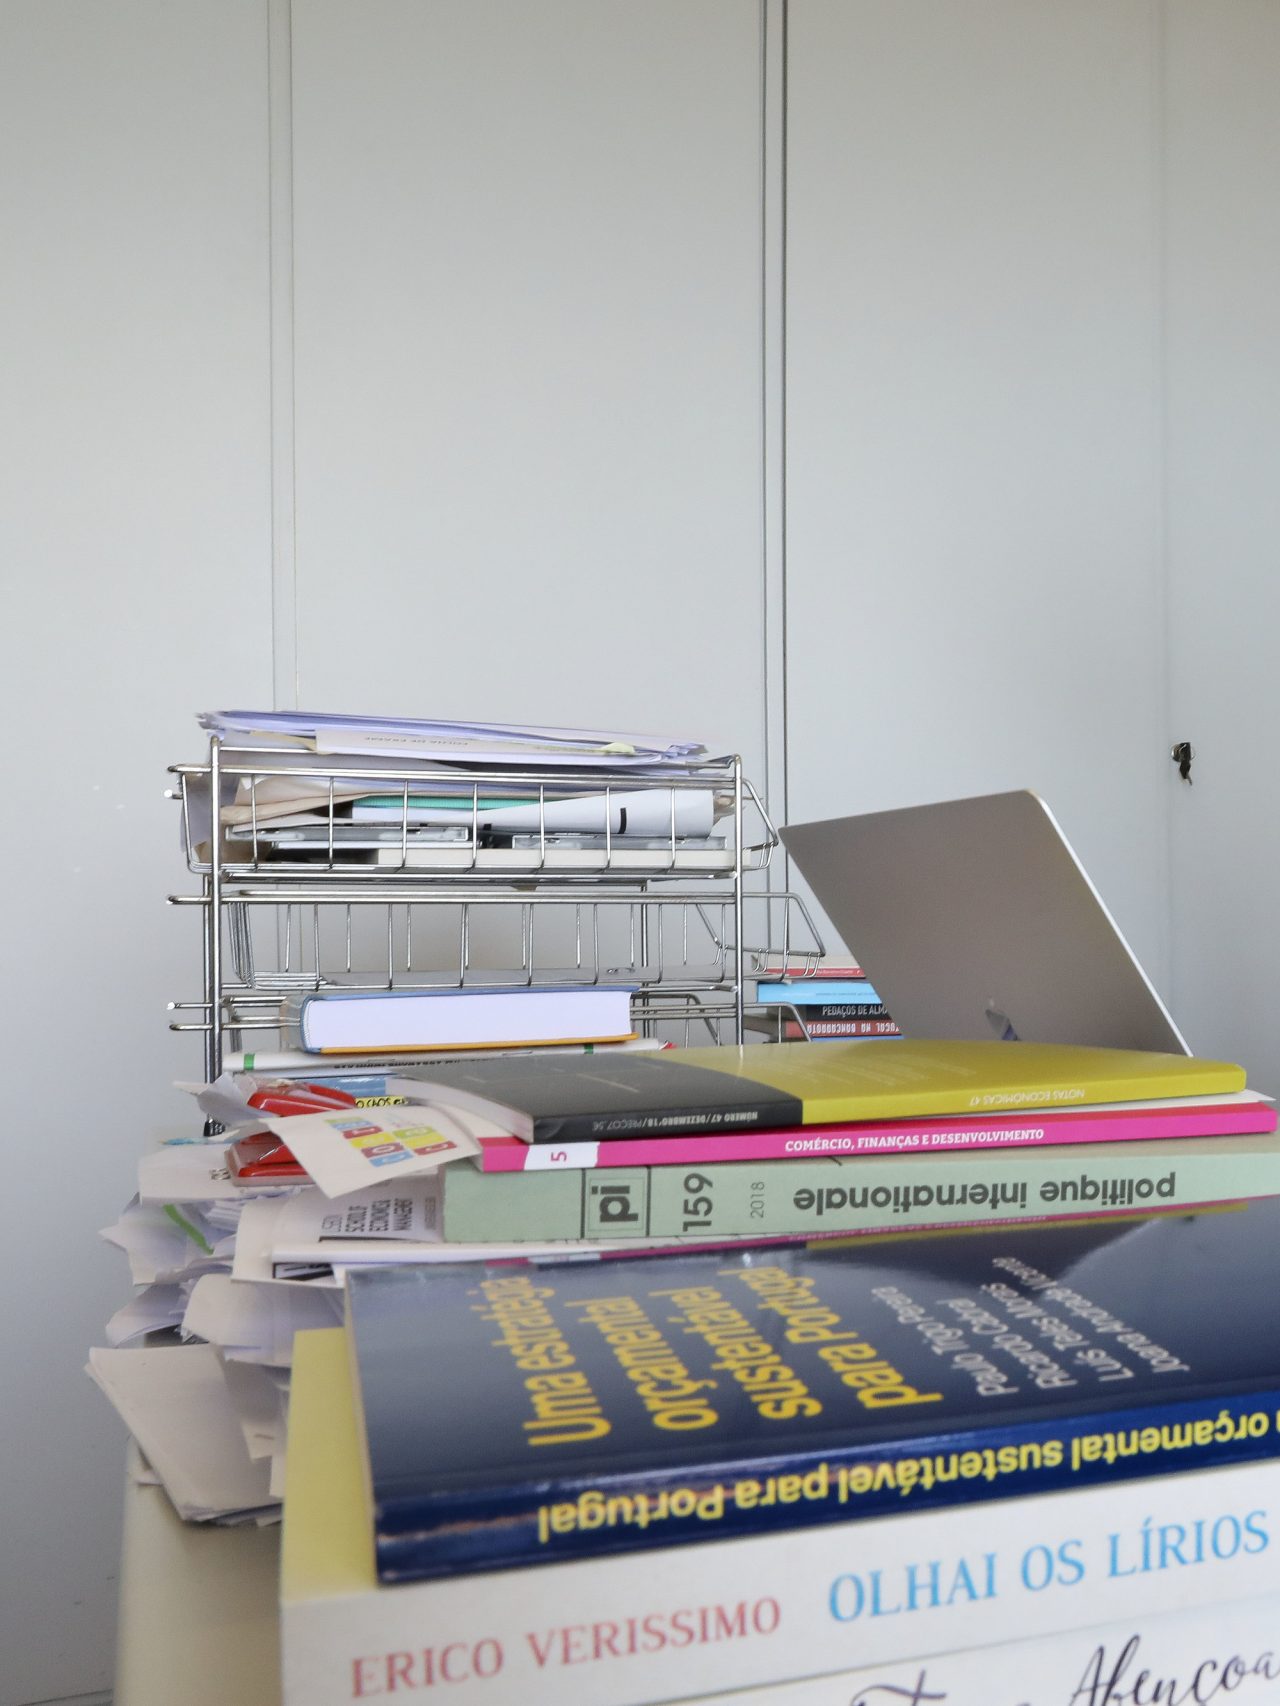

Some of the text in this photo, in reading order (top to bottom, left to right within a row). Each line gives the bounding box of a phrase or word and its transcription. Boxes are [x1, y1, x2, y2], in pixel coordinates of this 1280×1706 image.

[822, 1005, 857, 1018] PEDAÇOS
[858, 1005, 867, 1015] DE
[724, 1111, 758, 1123] NÚMERO
[1053, 1088, 1085, 1100] NOTAS
[551, 1150, 567, 1162] 5
[785, 1128, 1044, 1153] COMÉRCIO, FINANÇAS E DESENVOLVIMENTO
[591, 1185, 639, 1223] pi
[683, 1172, 713, 1232] 159
[750, 1181, 765, 1218] 2018
[793, 1172, 1176, 1216] politique internationale
[467, 1275, 612, 1446] Uma estratégia
[648, 1286, 823, 1420] sustentável
[717, 1266, 943, 1410] para Portugal
[1117, 1333, 1190, 1374] Joana
[565, 1296, 720, 1431] orçamental
[952, 1351, 1020, 1397] Paulo
[1071, 1409, 1269, 1471] orçamental
[735, 1462, 828, 1509] para
[838, 1438, 1063, 1503] sustentável
[538, 1484, 724, 1544] Portugal
[350, 1636, 504, 1699] ERICO
[526, 1596, 782, 1670] VERISSIMO
[827, 1551, 999, 1624] OLHAI
[1020, 1539, 1086, 1593] OS
[1107, 1508, 1270, 1579] LÍRIOS
